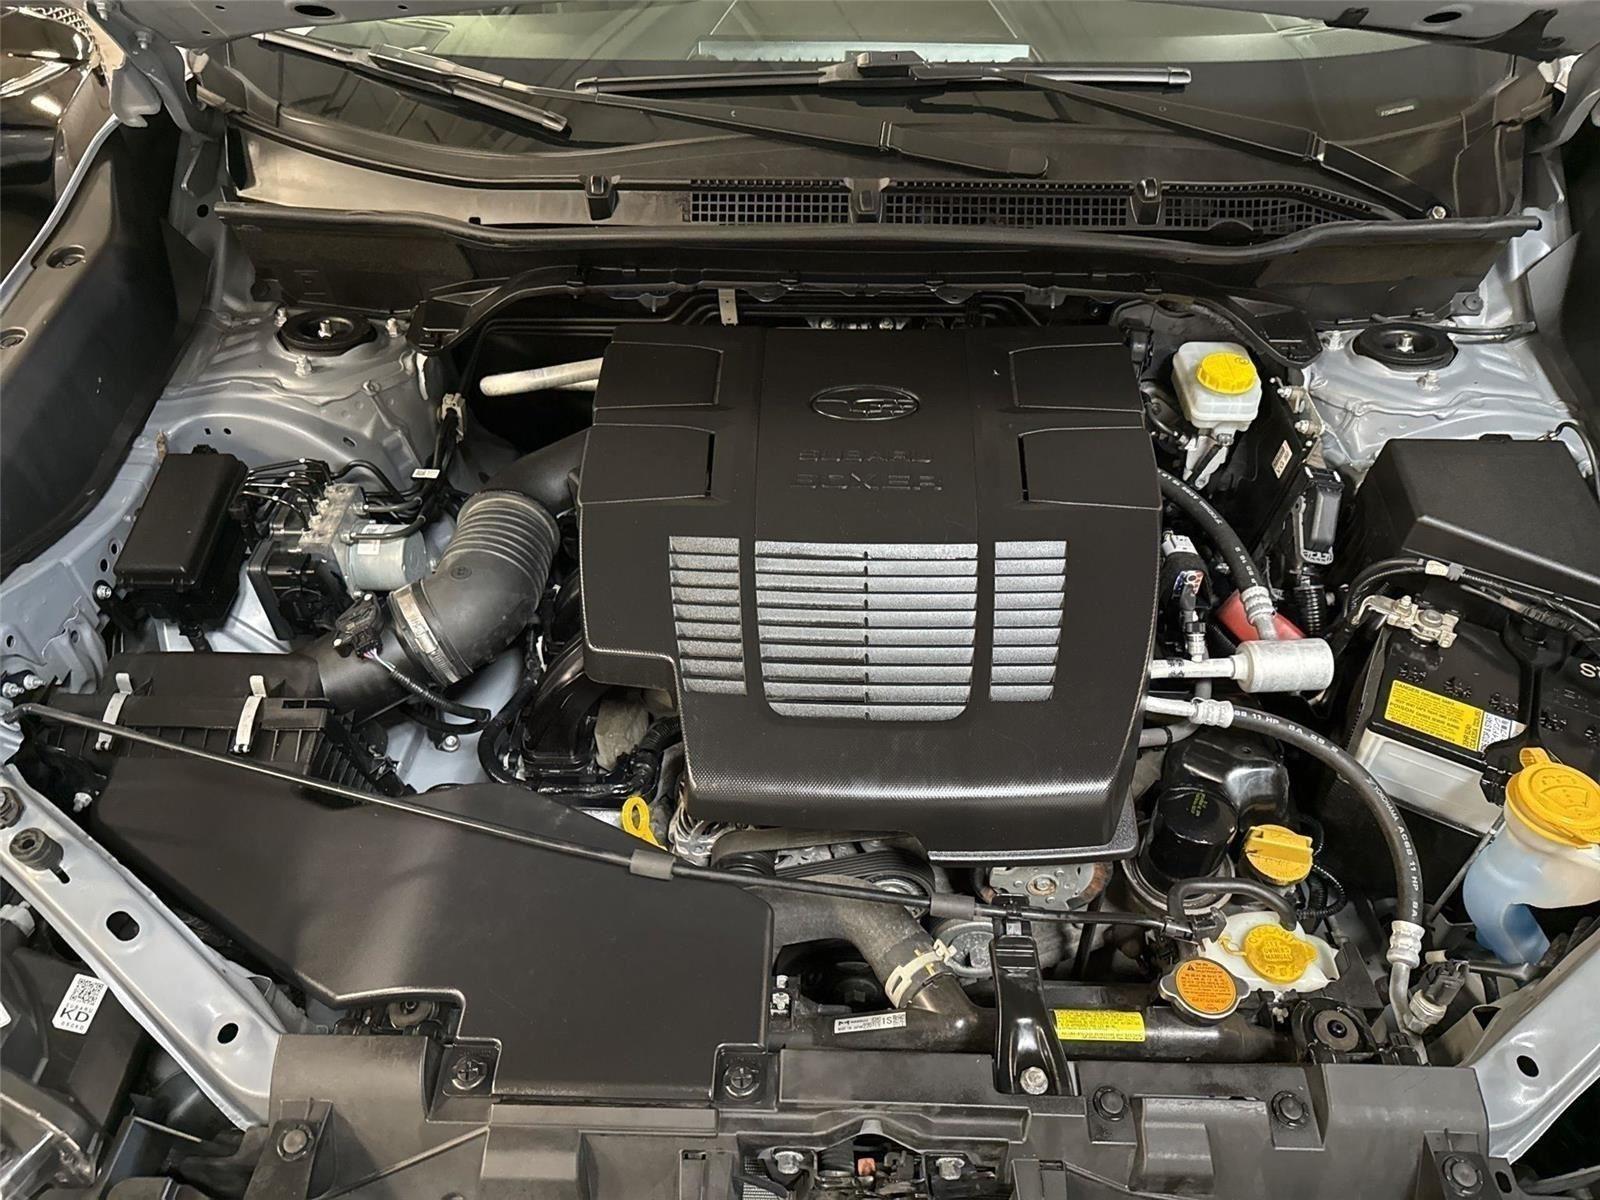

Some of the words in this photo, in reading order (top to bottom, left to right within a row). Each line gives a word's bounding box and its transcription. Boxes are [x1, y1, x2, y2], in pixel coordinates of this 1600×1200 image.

[799, 450, 932, 464] SUBARU
[1374, 786, 1399, 821] YOKOHAMA
[1409, 860, 1416, 871] 11
[1411, 875, 1419, 891] HP
[60, 1008, 89, 1022] KD
